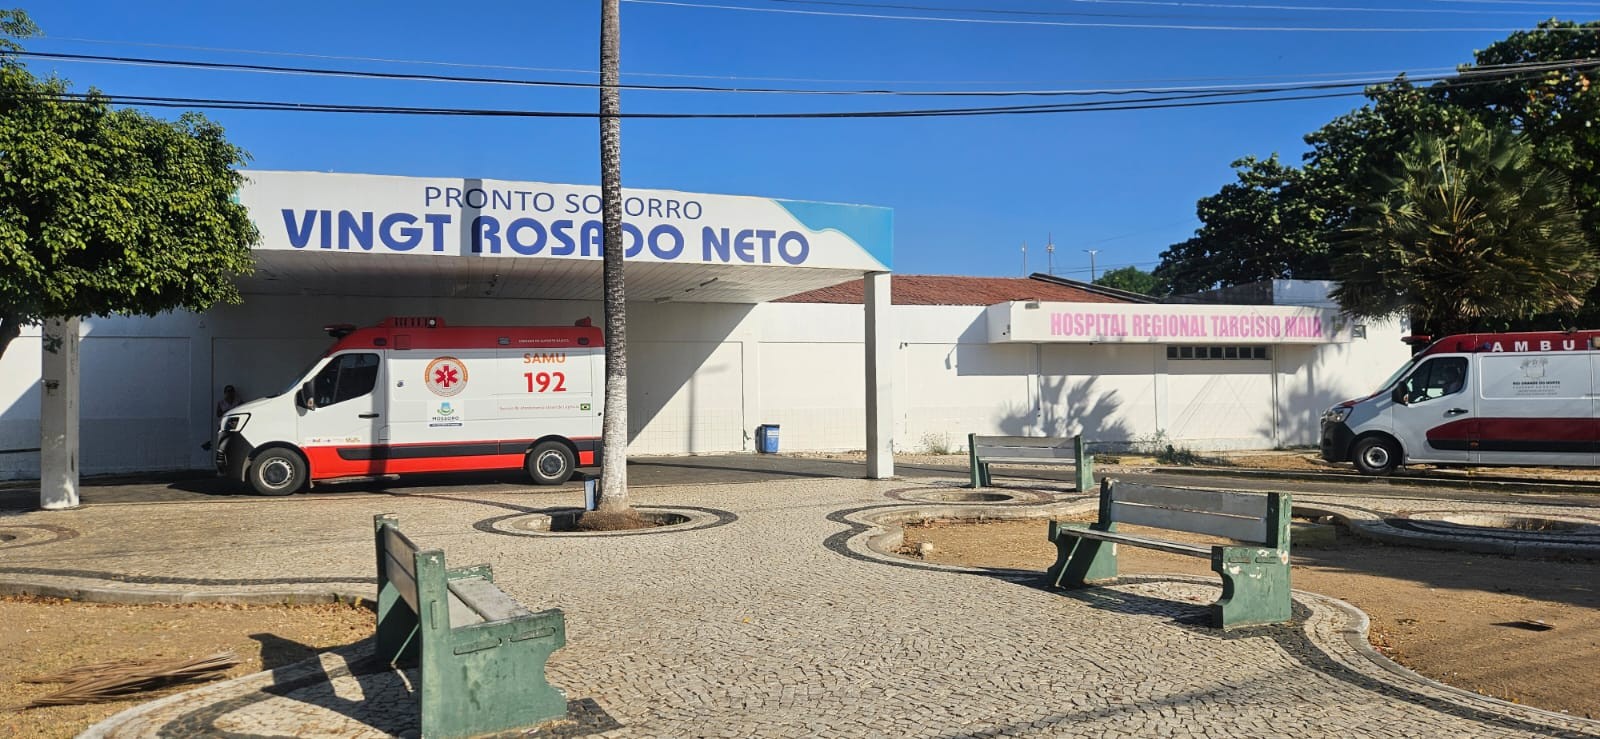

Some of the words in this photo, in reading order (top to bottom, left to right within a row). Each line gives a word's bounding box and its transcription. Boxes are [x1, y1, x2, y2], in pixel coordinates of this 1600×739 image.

[424, 186, 555, 212] PRONTO
[565, 193, 703, 220] SOORRO
[281, 208, 452, 252] VINGT
[702, 225, 810, 266] NETO
[1050, 312, 1129, 337] HOSPITAL
[1132, 314, 1208, 338] REGIONAL
[1210, 311, 1281, 338] TARCÍSIO
[1284, 315, 1322, 338] MAIA
[523, 352, 566, 364] SAMU
[524, 371, 567, 393] 192
